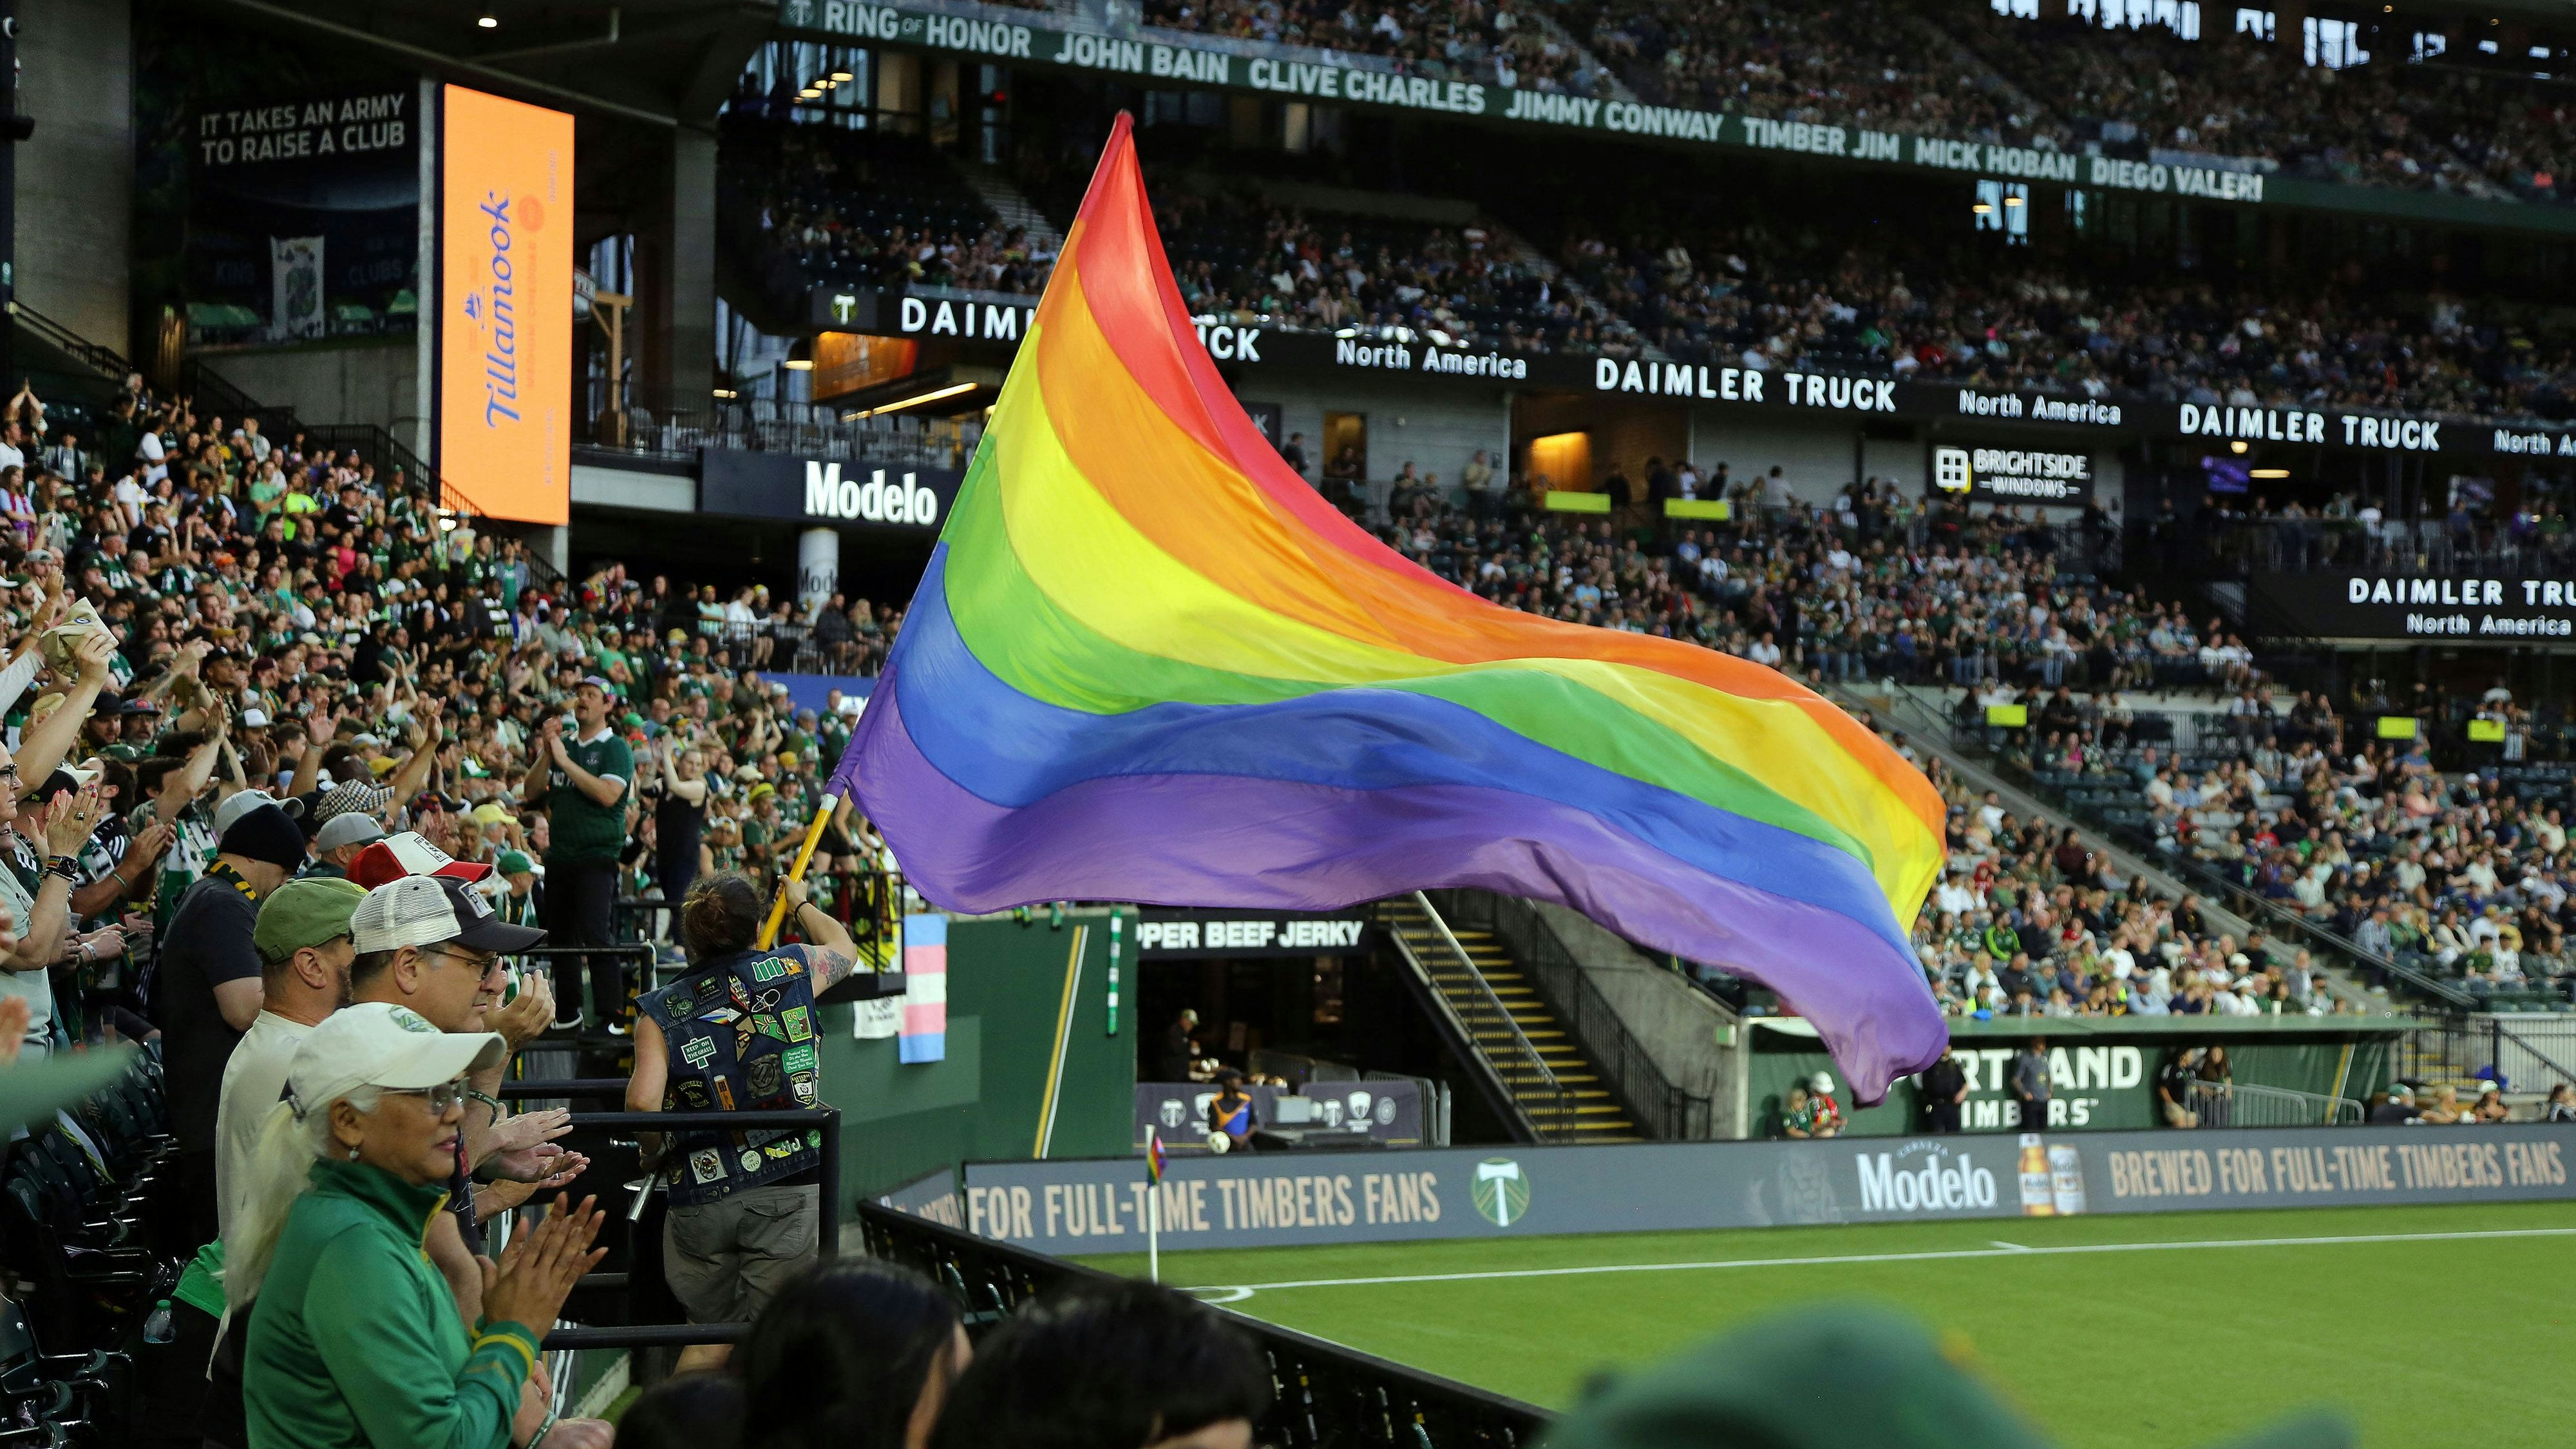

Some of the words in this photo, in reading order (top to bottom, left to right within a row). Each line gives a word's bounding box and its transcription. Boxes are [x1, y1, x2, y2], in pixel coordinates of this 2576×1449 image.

[824, 1, 899, 40] RING
[927, 17, 1030, 57] HONOR
[1054, 33, 1144, 73] JOHN
[1151, 46, 1229, 85] BAIN
[1249, 58, 1339, 98] CLIVE
[1345, 71, 1485, 114] CHARLES
[201, 112, 222, 136] IT
[227, 104, 296, 134] TAKES
[302, 100, 334, 126] AN
[340, 92, 406, 122] ARMY
[1505, 89, 1600, 128] JIMMY
[1605, 101, 1723, 143] CONWAY
[202, 138, 234, 166] TO
[242, 131, 312, 161] RAISE
[318, 128, 336, 155] A
[343, 120, 405, 153] CLUB
[1742, 117, 1846, 157] TIMBER
[1852, 131, 1899, 162] JIM
[1915, 138, 1980, 172] MICK
[1986, 146, 2076, 182] HOBAN
[2091, 157, 2168, 192] DIEGO
[2174, 167, 2262, 202] VALERI
[480, 189, 520, 428] Tillamook
[1336, 339, 1411, 370] North
[1423, 345, 1526, 379] America
[1596, 357, 1765, 404] DAIMLER
[1784, 372, 1897, 413] TRUCK
[1960, 389, 2023, 418] North
[2032, 393, 2121, 426] America
[2180, 403, 2325, 443] DAIMLER
[2341, 415, 2439, 451] TRUCK
[2494, 428, 2550, 455] North
[1973, 448, 2088, 480] BRIGHTSIDE
[1991, 475, 2067, 498] WINDOWS
[805, 460, 938, 526] Modelo
[2349, 578, 2503, 605] DAIMLER
[2406, 613, 2470, 635] North
[2479, 614, 2571, 636] America
[1205, 922, 1275, 949] BEEF
[1278, 921, 1363, 946] JERKY
[686, 1044, 699, 1053] KEEP
[697, 1046, 712, 1055] GRASS
[1911, 1046, 2143, 1092] RTAND
[1960, 1098, 2090, 1128] IMBRS
[1855, 1152, 1997, 1211] Modelo
[2108, 1150, 2212, 1198] BREWED
[2216, 1148, 2268, 1194] FOR
[2271, 1144, 2396, 1192] FULL-TIME
[2396, 1142, 2503, 1188] TIMBERS
[2506, 1141, 2566, 1186] FANS
[968, 1186, 1034, 1240] FOR
[1220, 1173, 1355, 1228] TIMBERS
[1363, 1171, 1441, 1225] FANS
